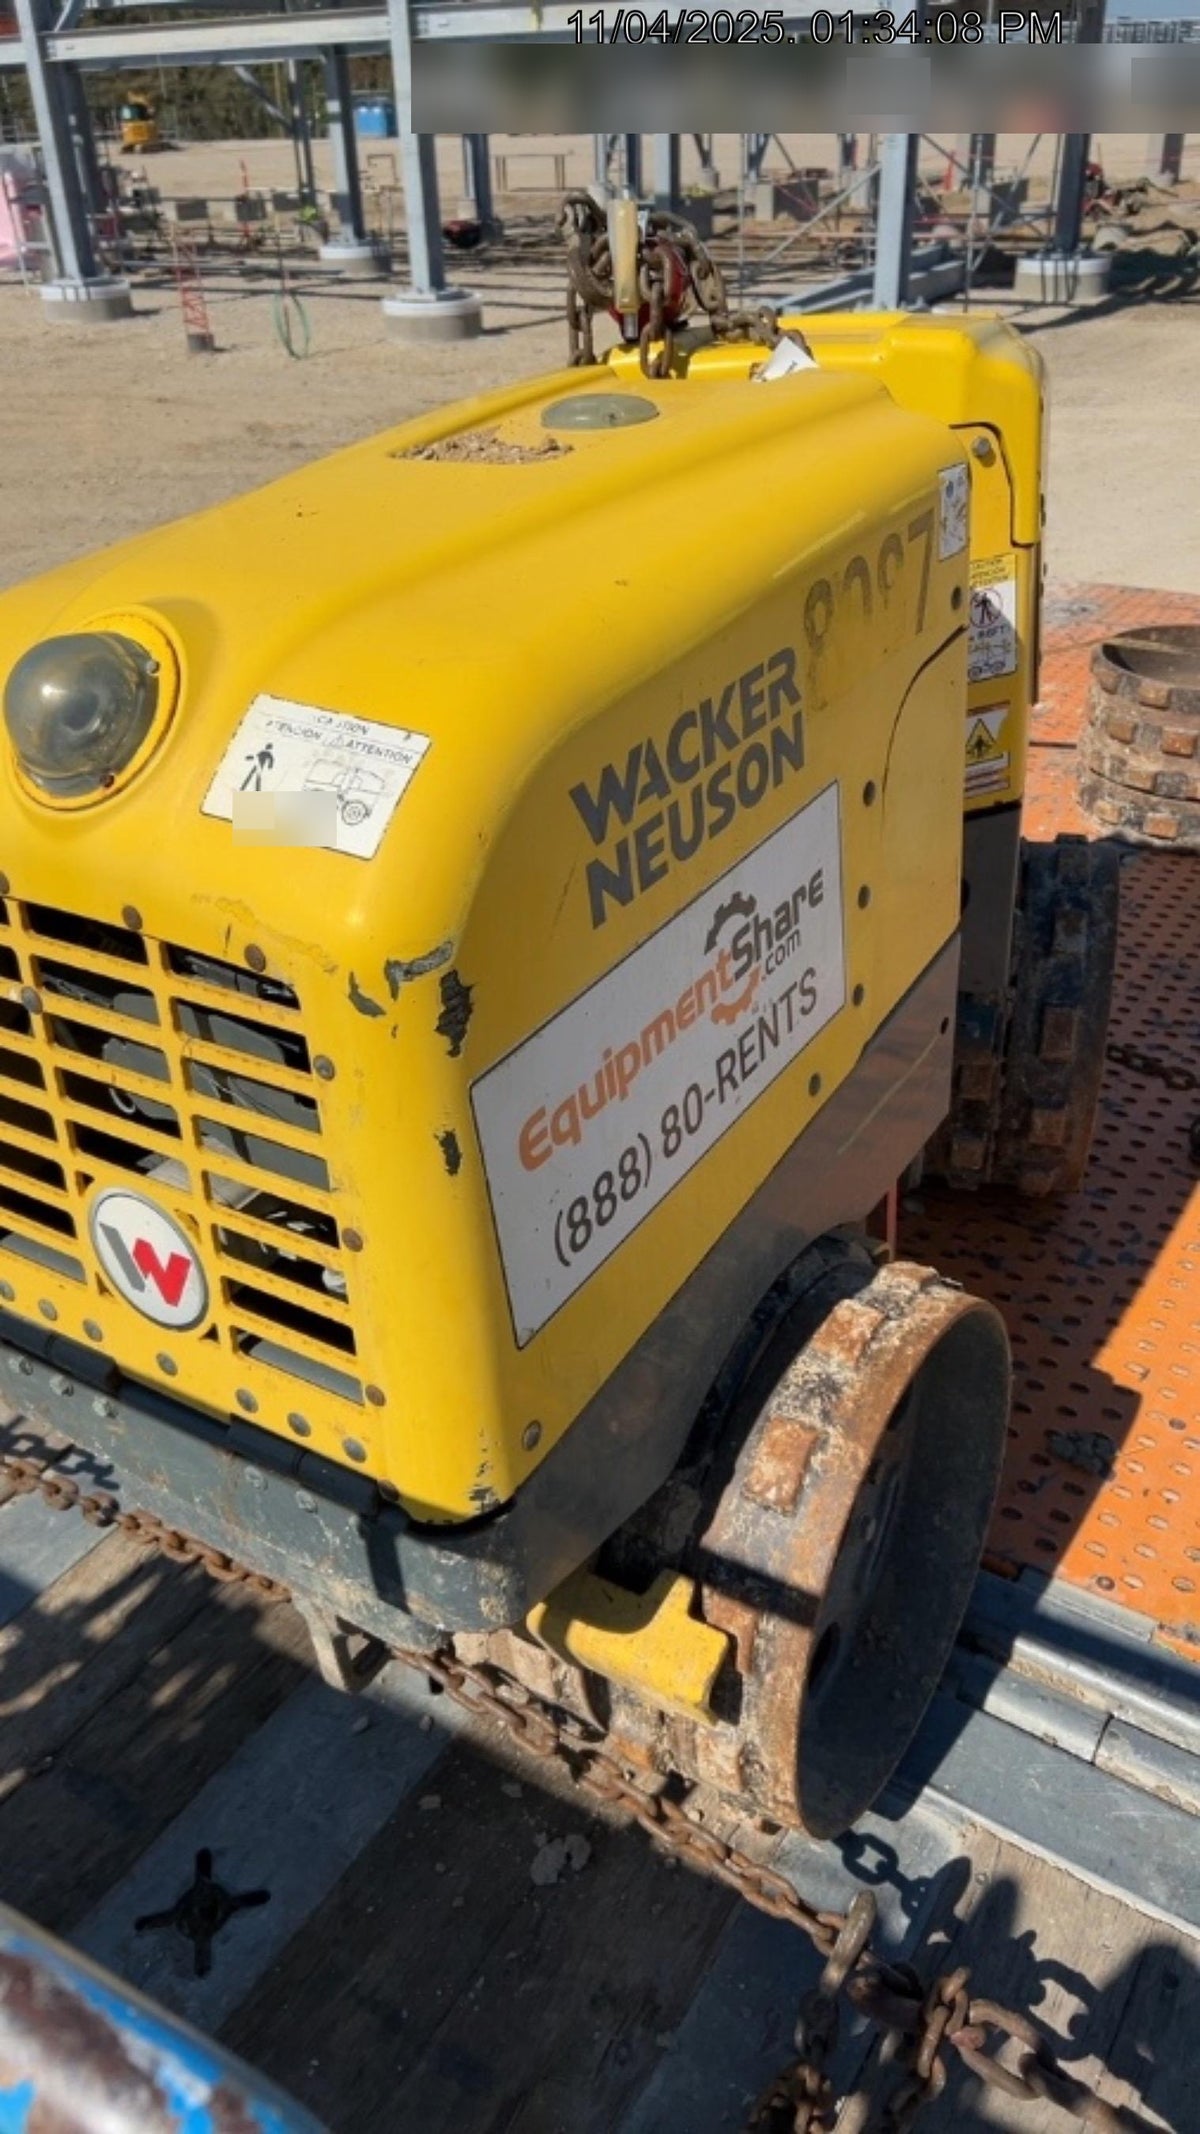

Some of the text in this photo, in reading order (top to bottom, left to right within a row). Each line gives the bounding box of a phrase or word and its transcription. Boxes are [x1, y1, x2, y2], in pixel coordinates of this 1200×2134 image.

[569, 647, 801, 846] WACKER
[586, 711, 805, 930] NEUSON
[518, 869, 824, 1172] EquipmentShare
[761, 928, 801, 982] .com
[554, 966, 818, 1267] (888) 80-RENTS
